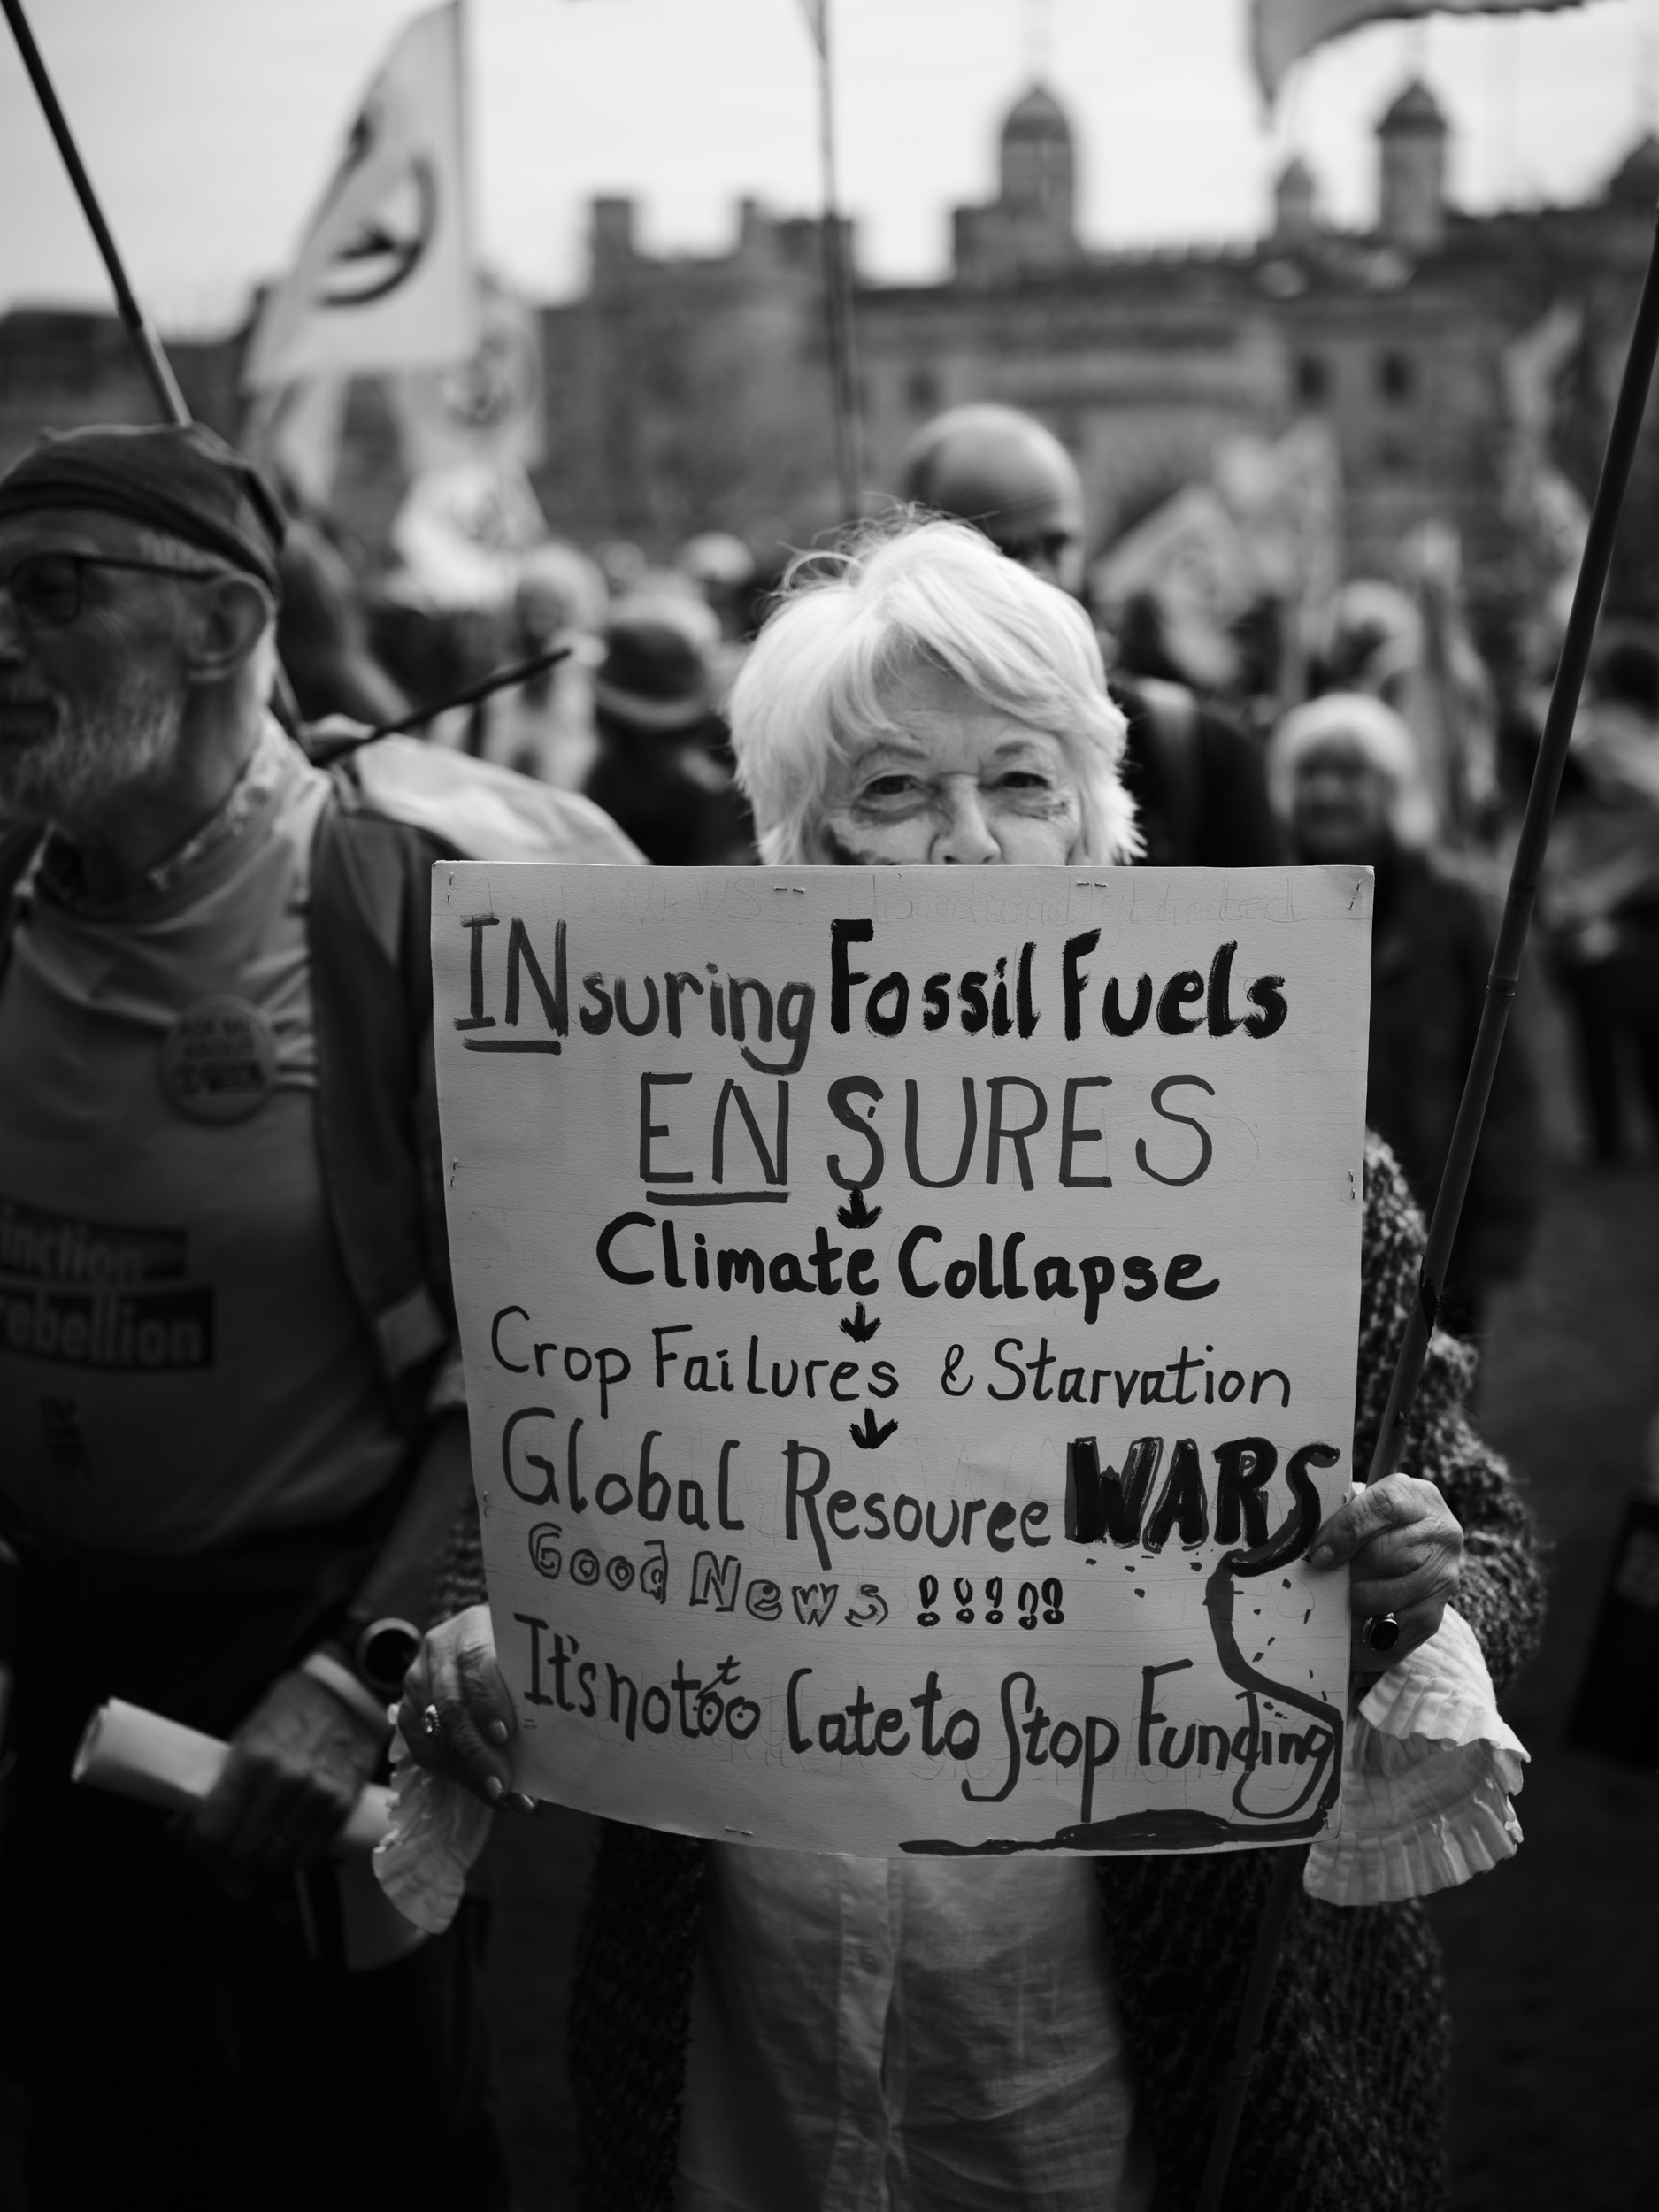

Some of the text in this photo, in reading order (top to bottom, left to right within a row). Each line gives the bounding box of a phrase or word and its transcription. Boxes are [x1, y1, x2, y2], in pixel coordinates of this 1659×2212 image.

[454, 913, 1288, 1075] INsuring Fossil Fuels
[596, 1212, 1220, 1325] Climate Collapse
[491, 1305, 1291, 1419] Crop Failures & Starvation
[502, 1407, 745, 1531] Global
[1064, 1435, 1341, 1577] WARS
[528, 1522, 1064, 1630] Good News !!!!!
[513, 1612, 597, 1717] It's
[910, 1671, 980, 1761] to
[961, 1671, 1120, 1823] Stop
[1138, 1658, 1338, 1821] Funding
